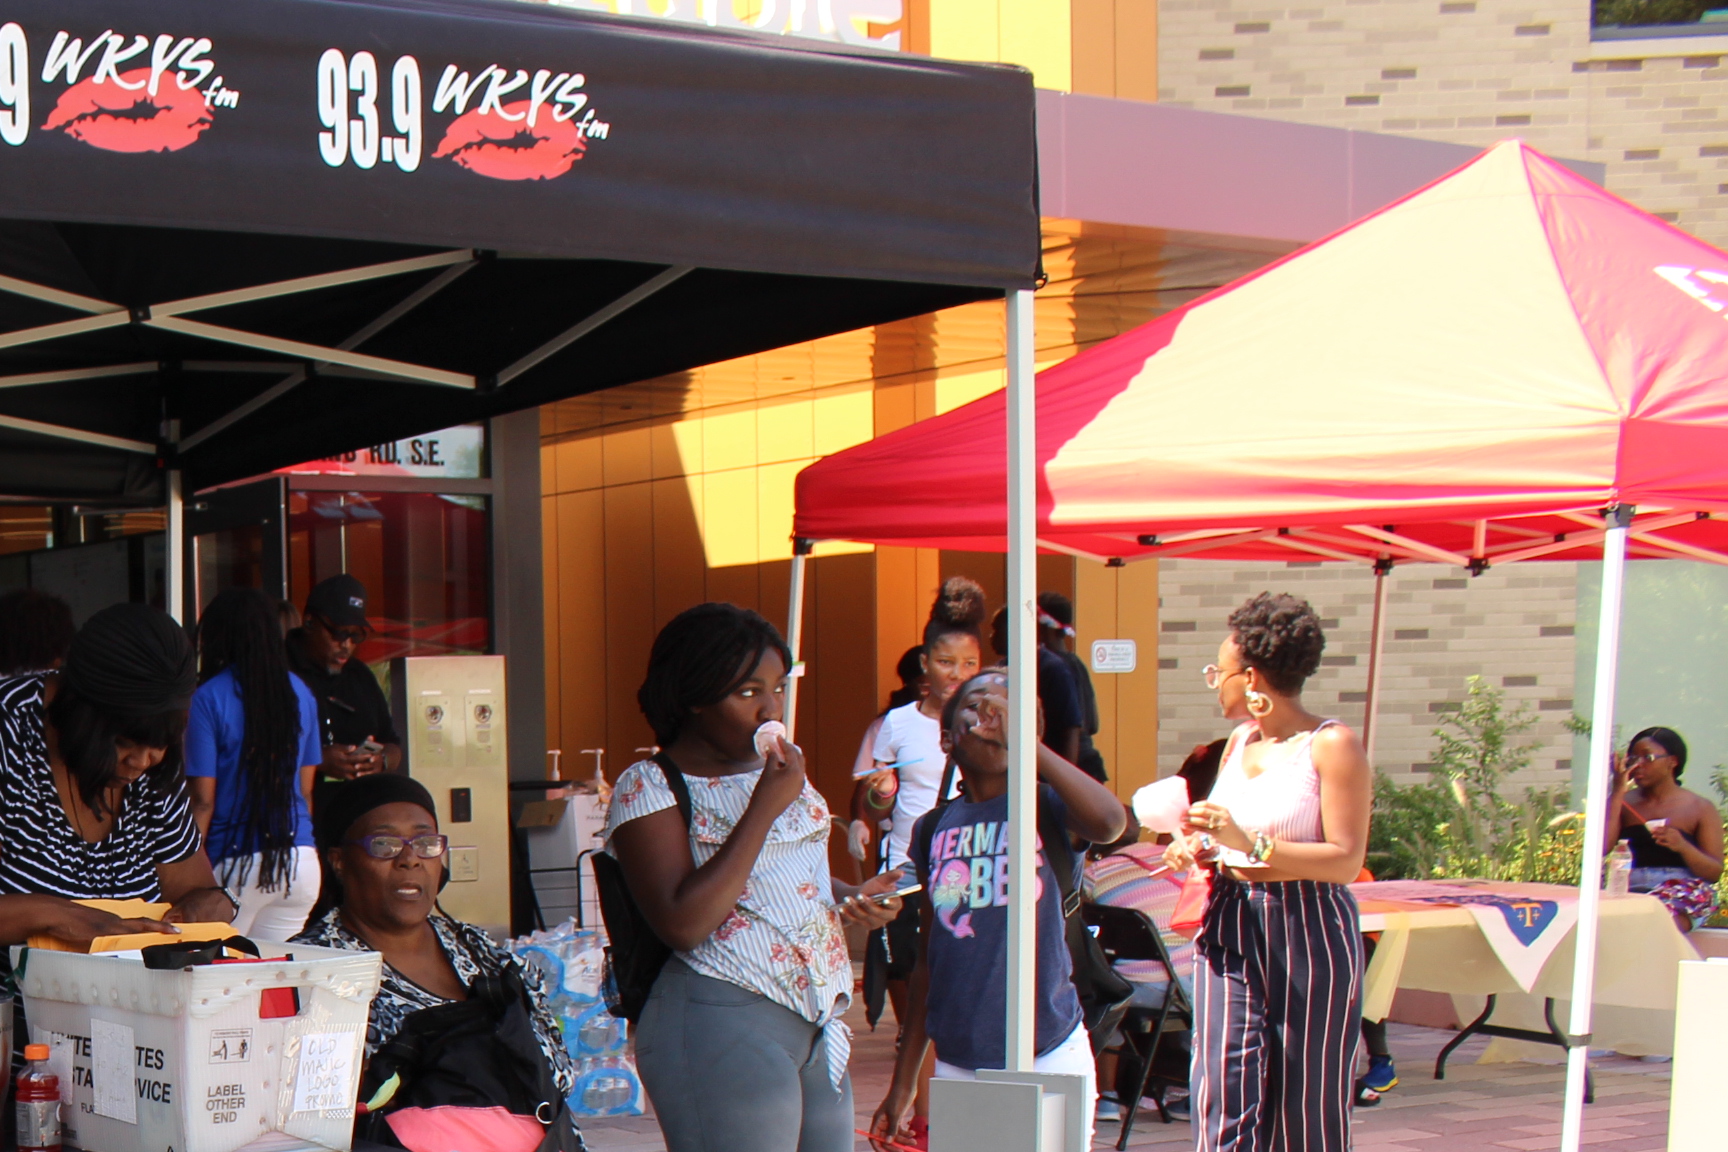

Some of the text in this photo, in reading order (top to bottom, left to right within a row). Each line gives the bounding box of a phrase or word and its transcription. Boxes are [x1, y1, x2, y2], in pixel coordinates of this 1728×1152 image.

[41, 29, 215, 97] WKYS
[202, 76, 240, 108] fm
[317, 48, 610, 173] 93.9 WKYS fm
[308, 1038, 337, 1056] OLD
[207, 1084, 245, 1098] LABEL
[206, 1097, 245, 1112] OTHER
[213, 1111, 237, 1124] END
